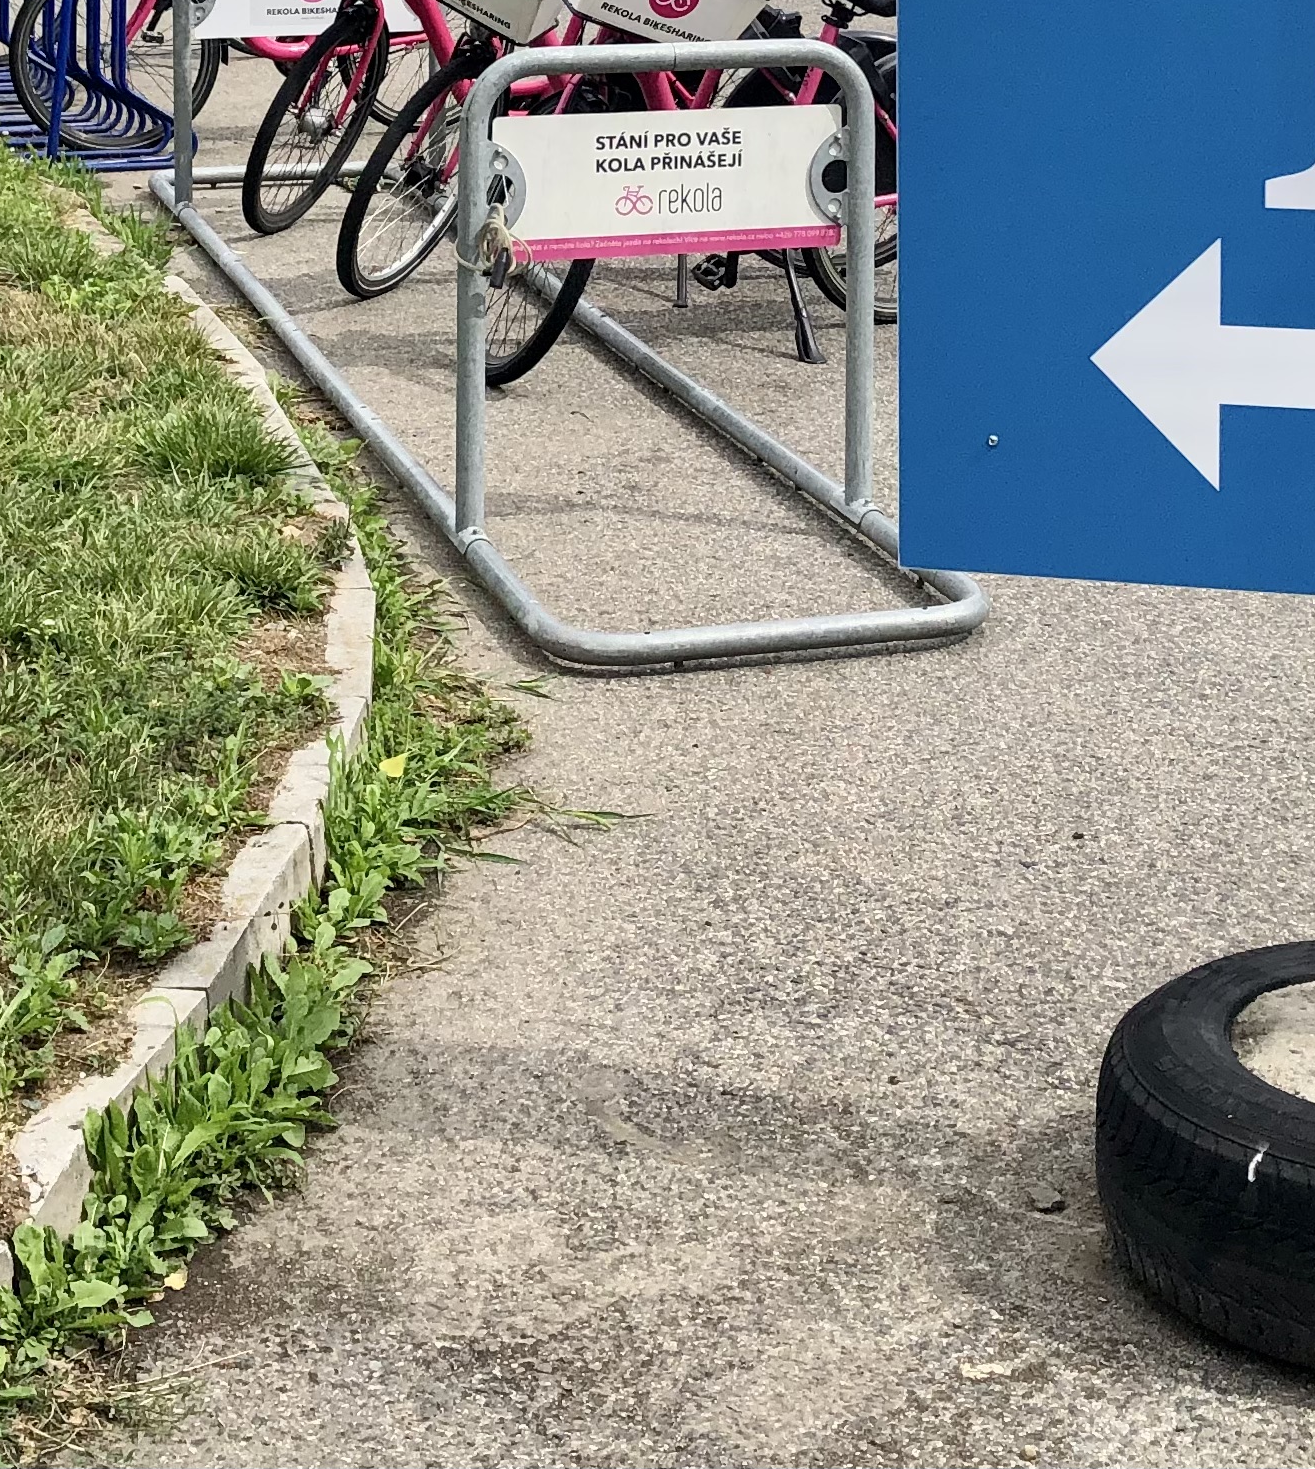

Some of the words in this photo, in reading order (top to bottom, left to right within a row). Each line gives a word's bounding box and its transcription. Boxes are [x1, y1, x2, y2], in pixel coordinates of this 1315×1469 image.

[266, 7, 300, 16] REKOLA
[301, 6, 340, 15] BIKESHA
[600, 1, 642, 24] REKOLA
[595, 130, 649, 151] STÁNÍ
[653, 132, 692, 149] PRO
[696, 127, 742, 146] VAŠE
[595, 156, 646, 174] KOLA
[650, 149, 743, 171] PŘINÁŠEJÍ
[658, 182, 722, 215] rekola
